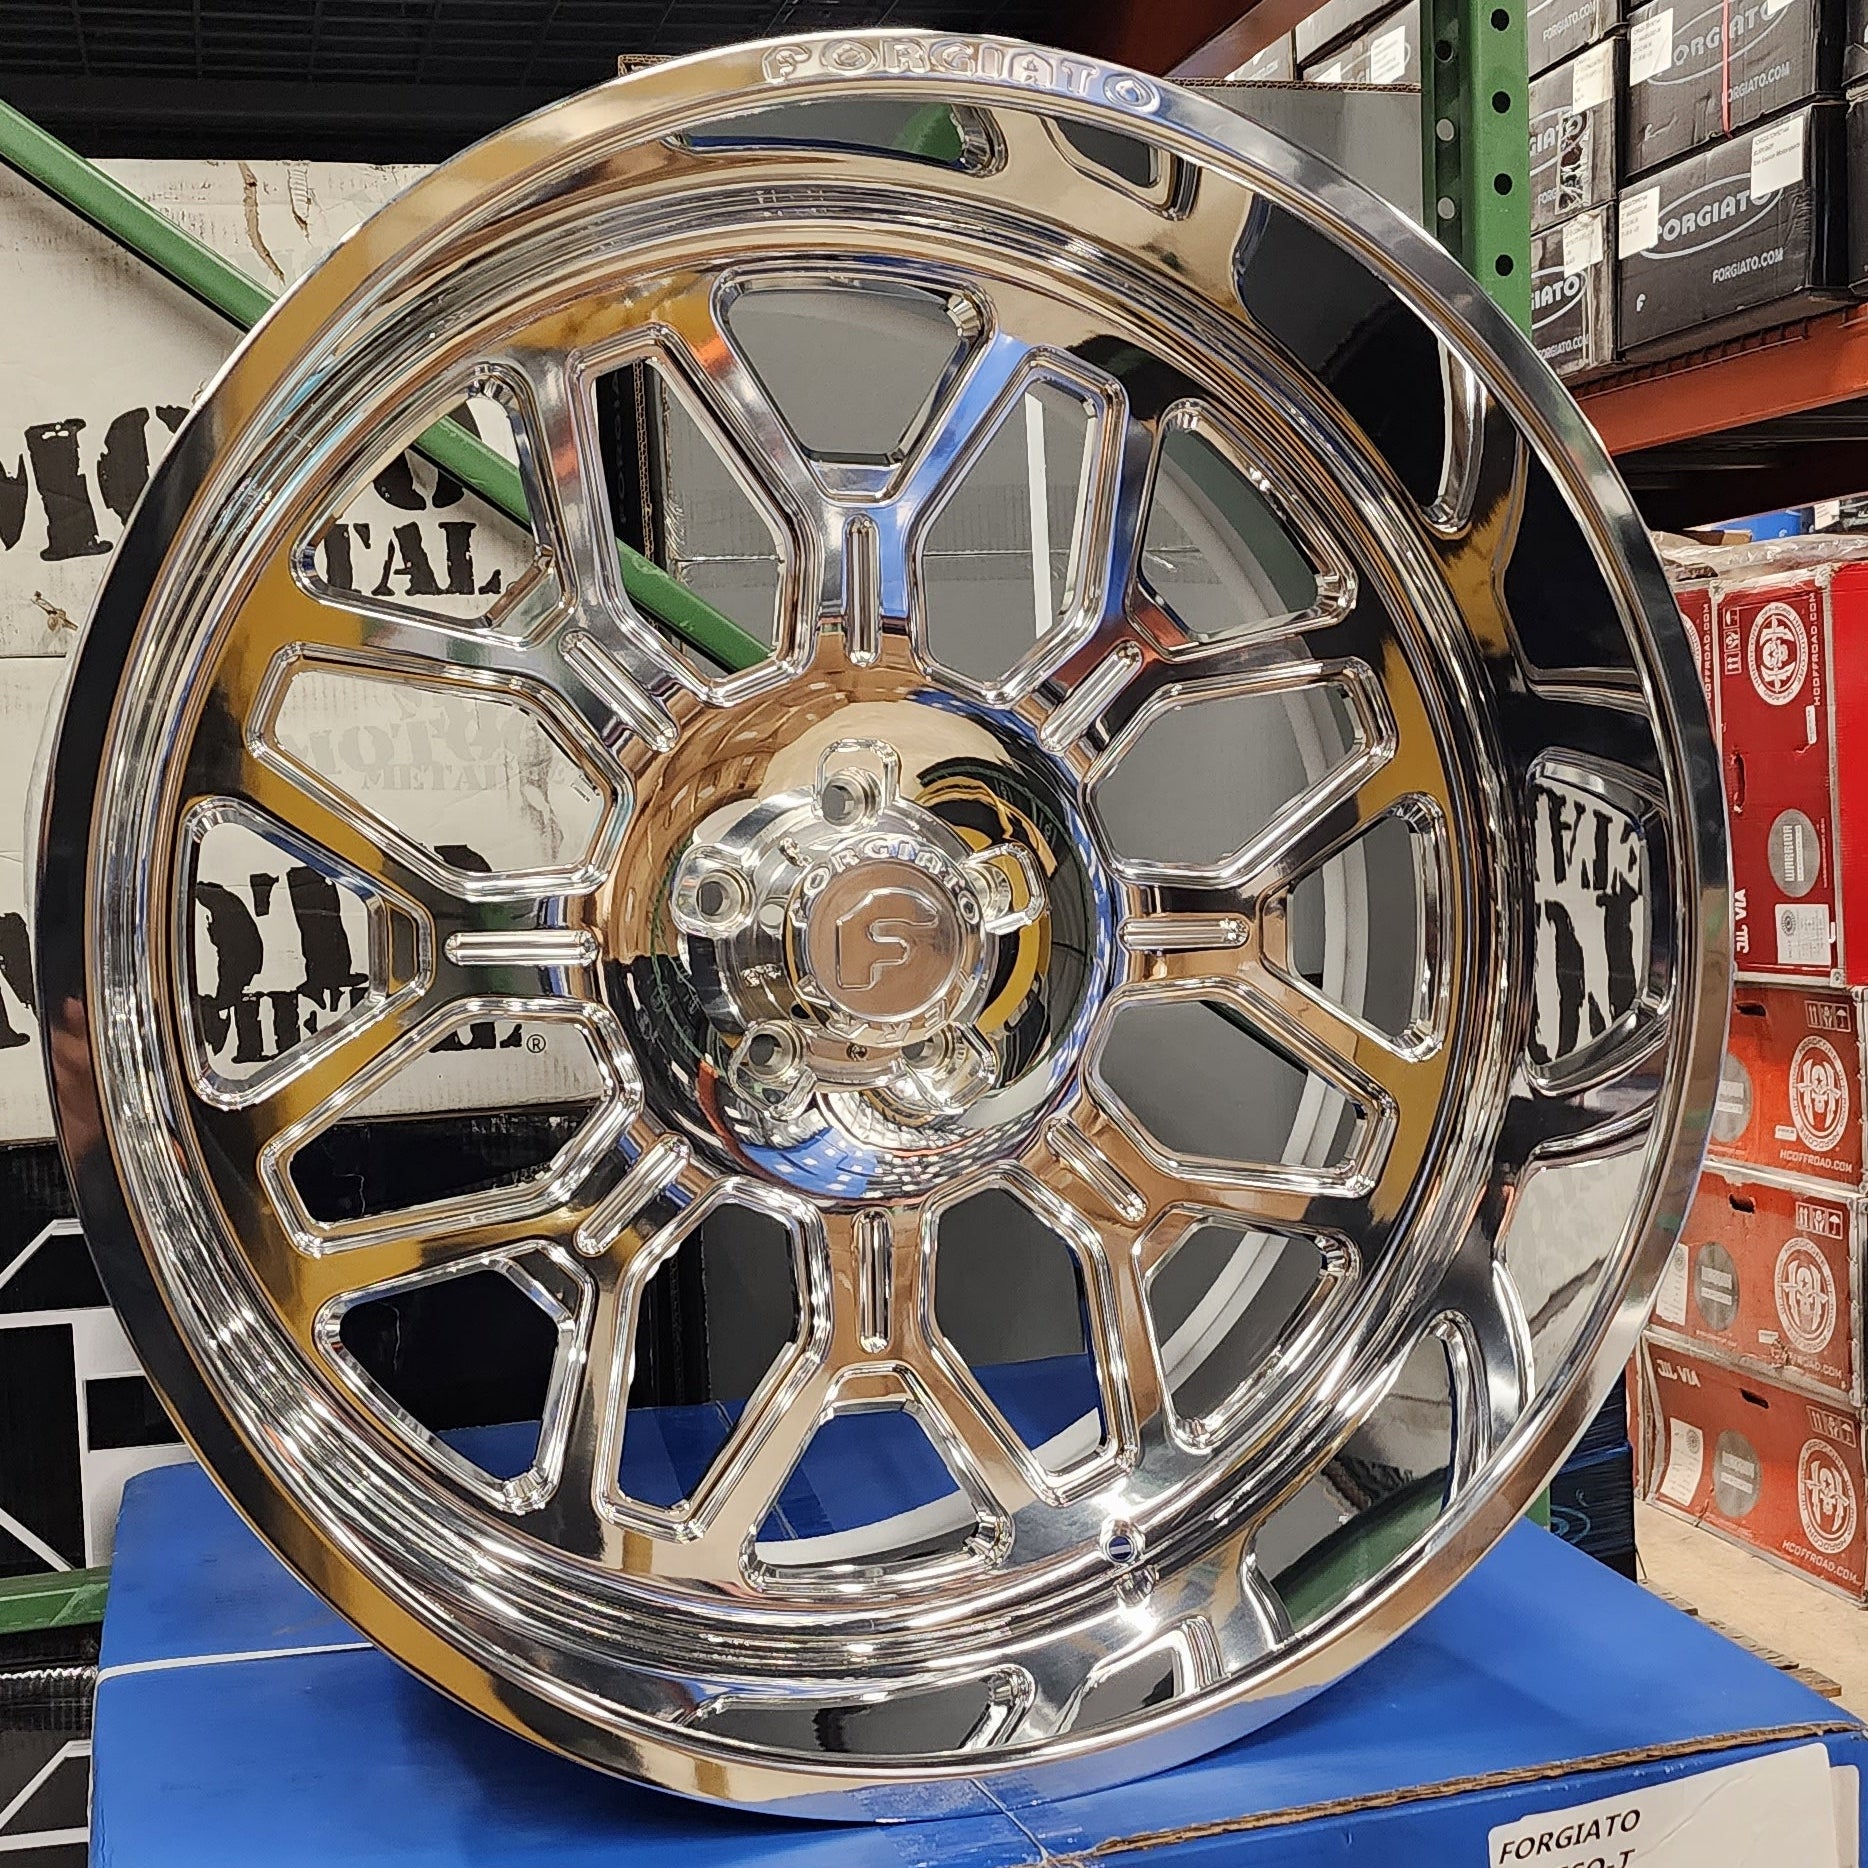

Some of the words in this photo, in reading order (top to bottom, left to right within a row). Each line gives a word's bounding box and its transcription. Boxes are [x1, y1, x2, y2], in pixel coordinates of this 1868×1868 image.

[761, 36, 1161, 114] FORGIATO
[1712, 247, 1783, 284] FORGIATO.COM
[1809, 592, 1821, 706] HCOFFROAD.COM
[1780, 1149, 1852, 1174] HCOFFROAD.COM
[1782, 1539, 1859, 1586] HCOFFROAD.COM
[1499, 1809, 1641, 1864] FORGIATO
